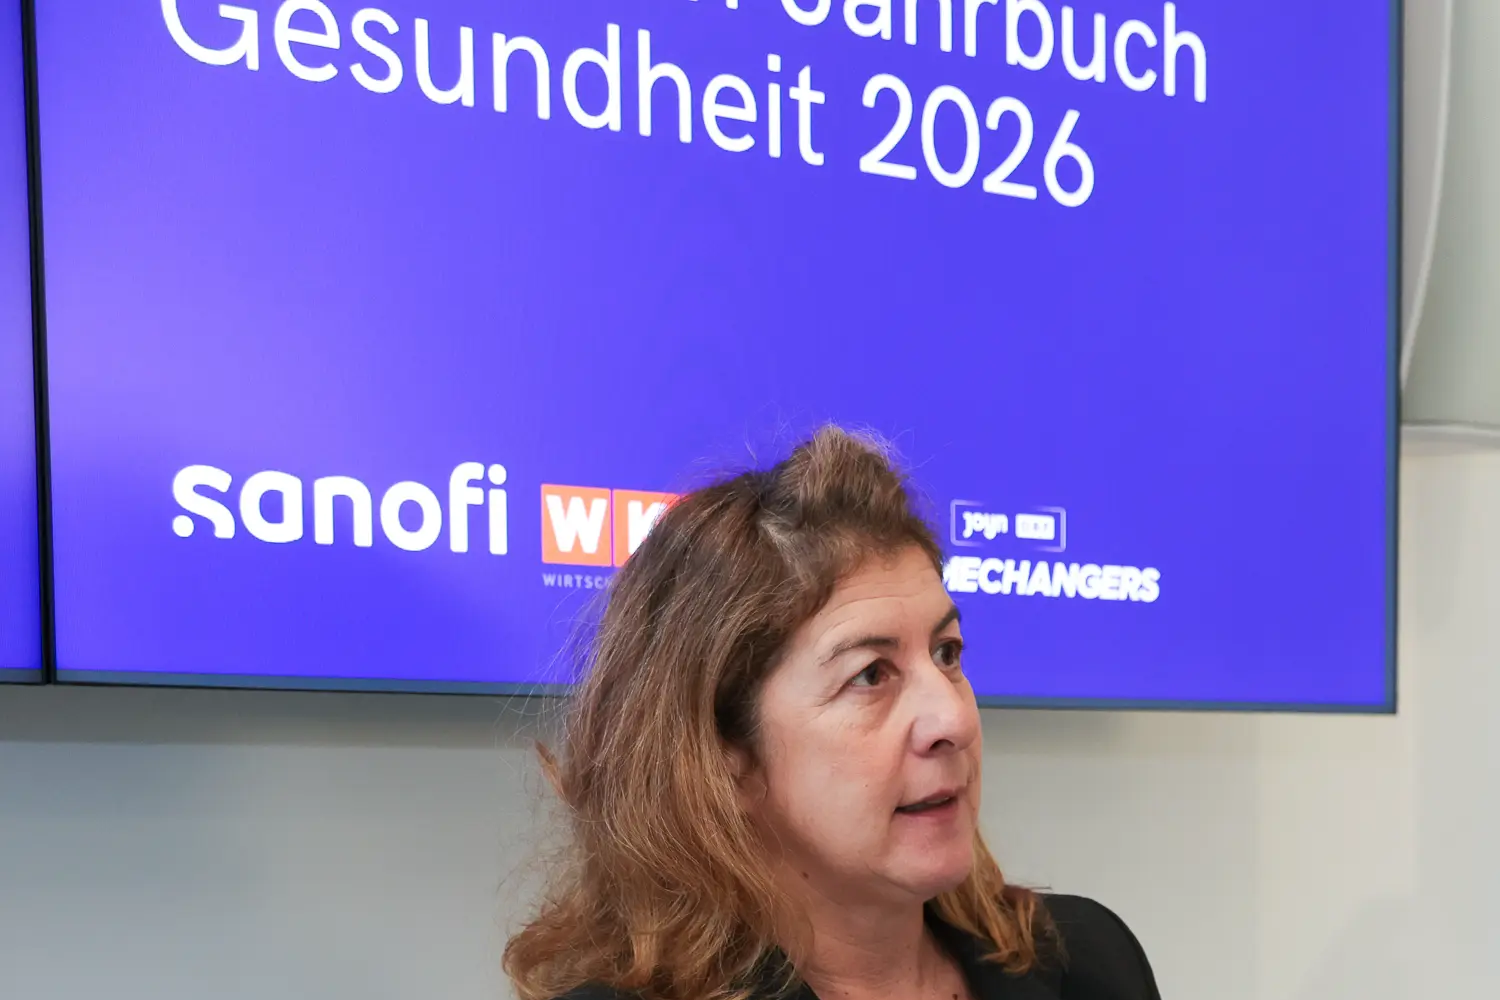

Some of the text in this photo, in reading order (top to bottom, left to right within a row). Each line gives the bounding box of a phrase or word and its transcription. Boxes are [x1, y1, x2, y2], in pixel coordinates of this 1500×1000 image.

[780, 0, 1208, 103] ahrbuch
[160, 0, 1096, 208] Gesundheit 2026
[171, 461, 509, 557] sanofi
[962, 511, 1009, 541] joyn
